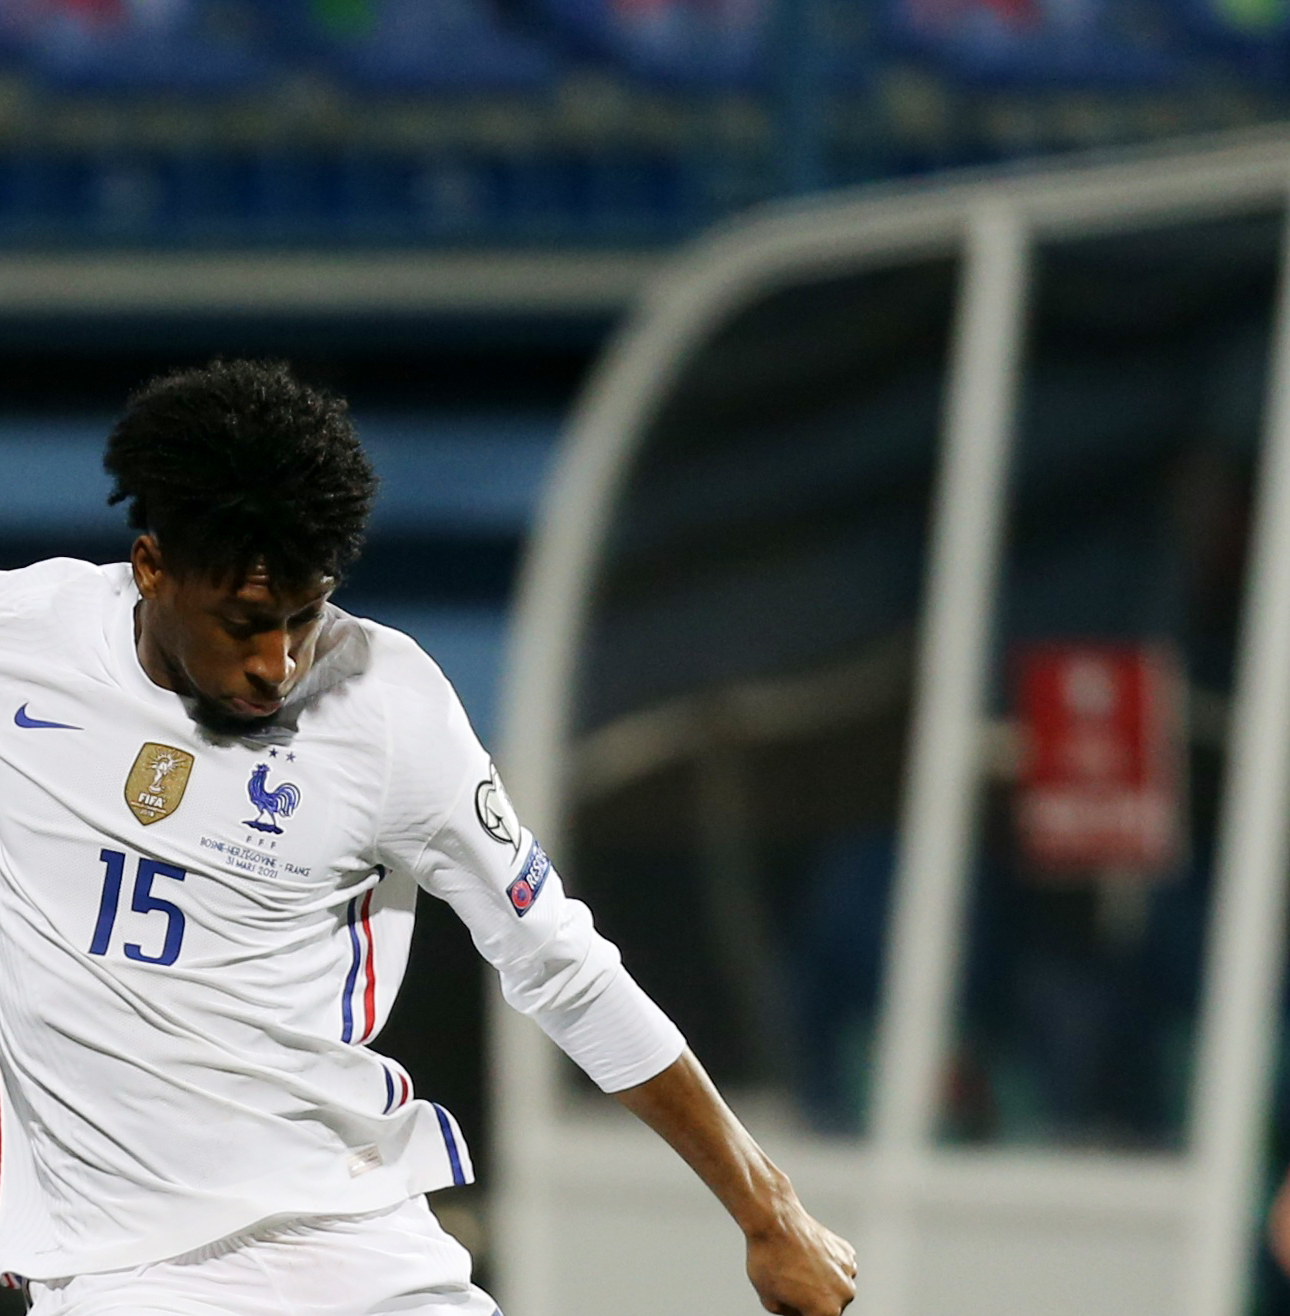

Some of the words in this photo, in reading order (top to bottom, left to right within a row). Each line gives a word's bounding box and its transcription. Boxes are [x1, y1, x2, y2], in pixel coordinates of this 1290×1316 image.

[138, 792, 164, 808] FIFA
[258, 866, 279, 879] 2021
[88, 848, 187, 967] 15
